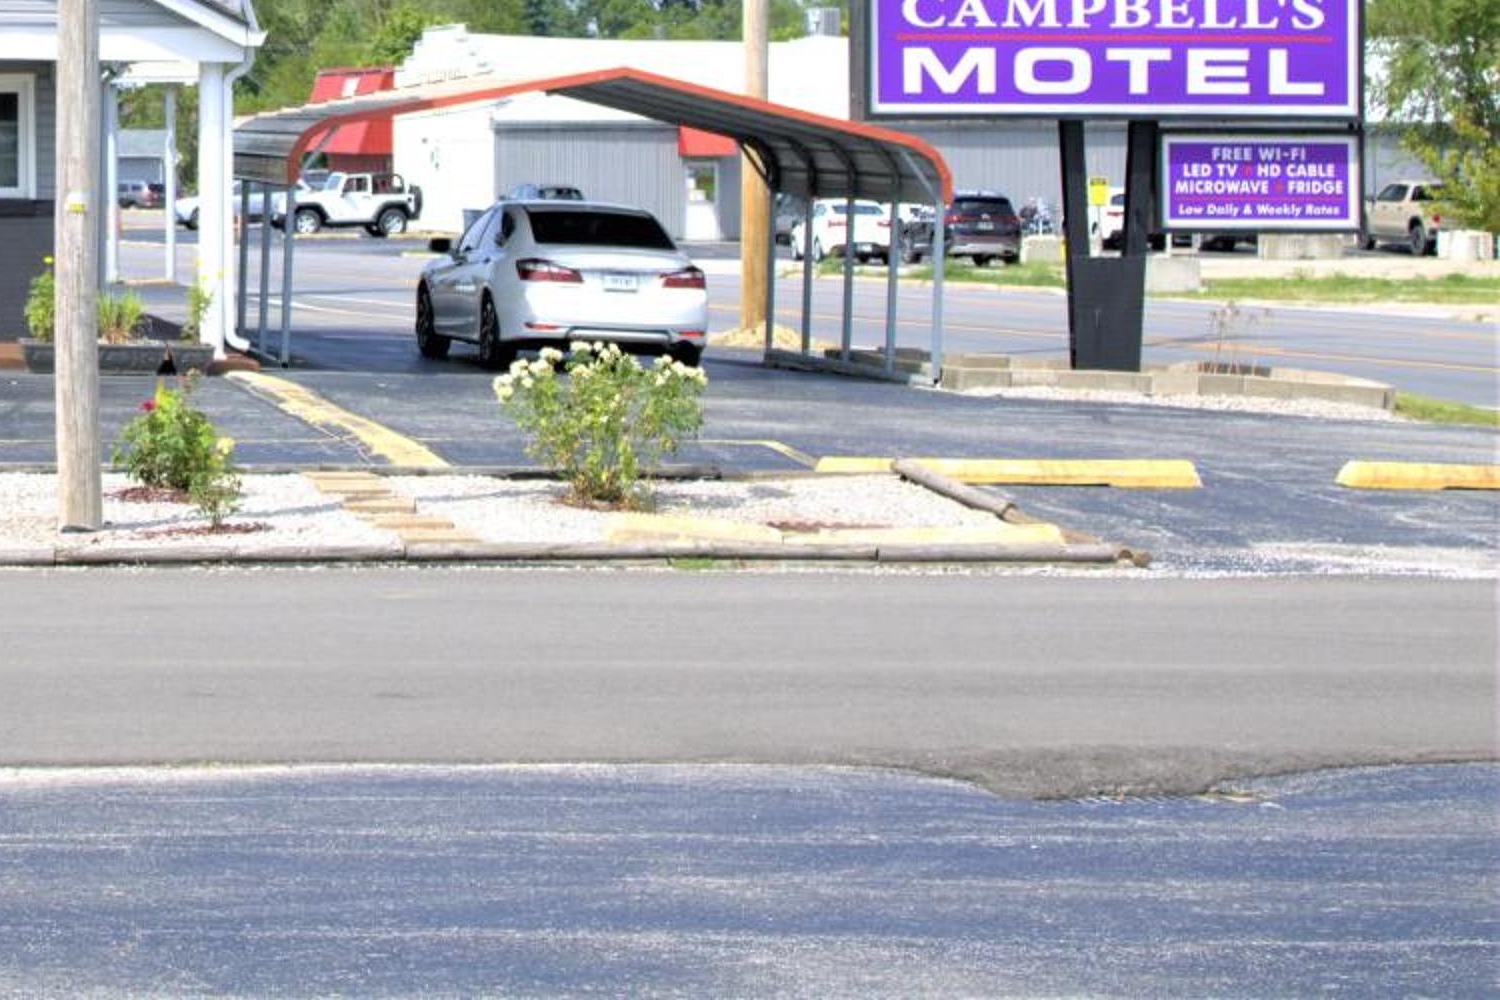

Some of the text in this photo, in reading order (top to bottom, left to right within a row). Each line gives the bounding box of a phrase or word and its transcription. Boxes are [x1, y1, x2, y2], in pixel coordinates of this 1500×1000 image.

[903, 47, 1324, 95] MOTEL
[1212, 147, 1305, 160] FREE WI-FI
[1184, 164, 1334, 177] LED TV HD CABLE
[1176, 180, 1342, 194] MICROWAVE FRIDGE
[1179, 204, 1339, 216] Low Daily & Weekly Rates
